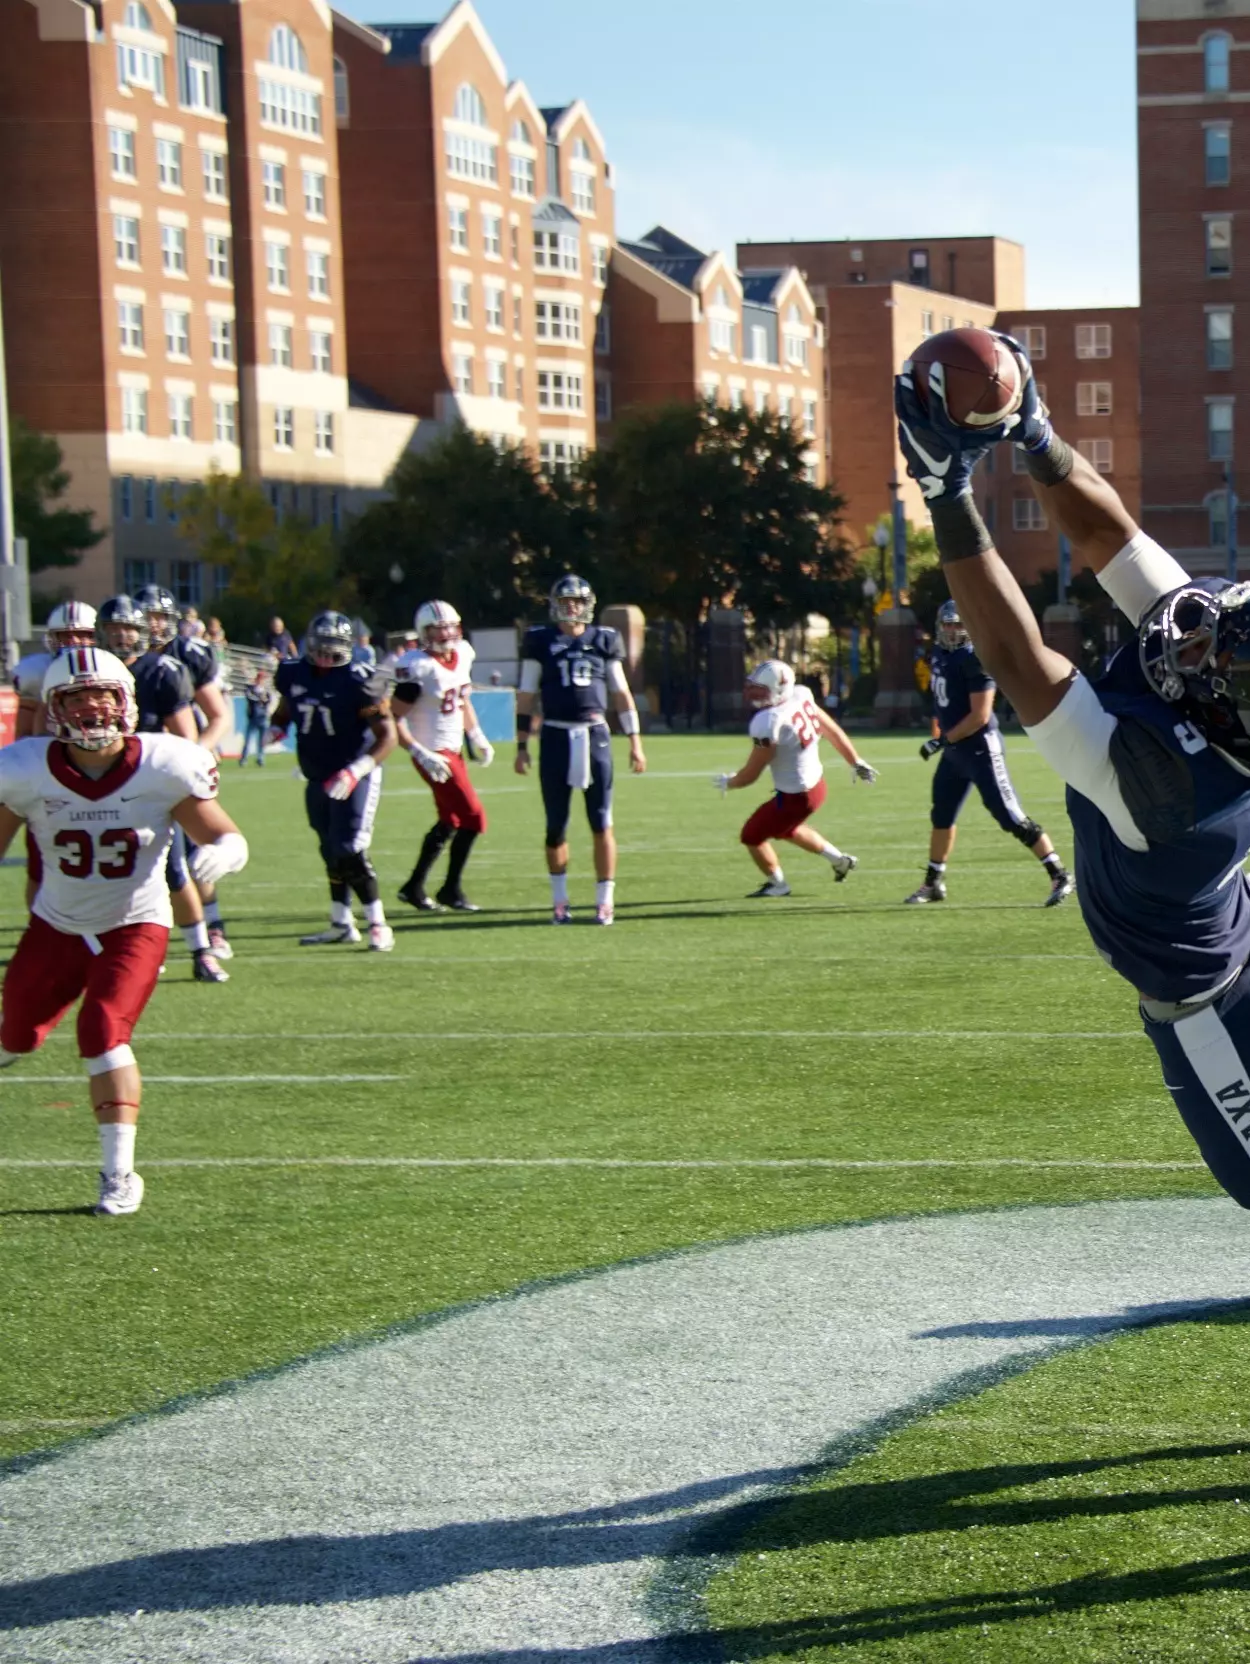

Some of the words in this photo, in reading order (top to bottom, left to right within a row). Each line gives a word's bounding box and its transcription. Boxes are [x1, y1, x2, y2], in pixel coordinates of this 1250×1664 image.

[297, 703, 336, 737] 71
[69, 810, 121, 822] LAFAYETTE
[53, 827, 141, 880] 33
